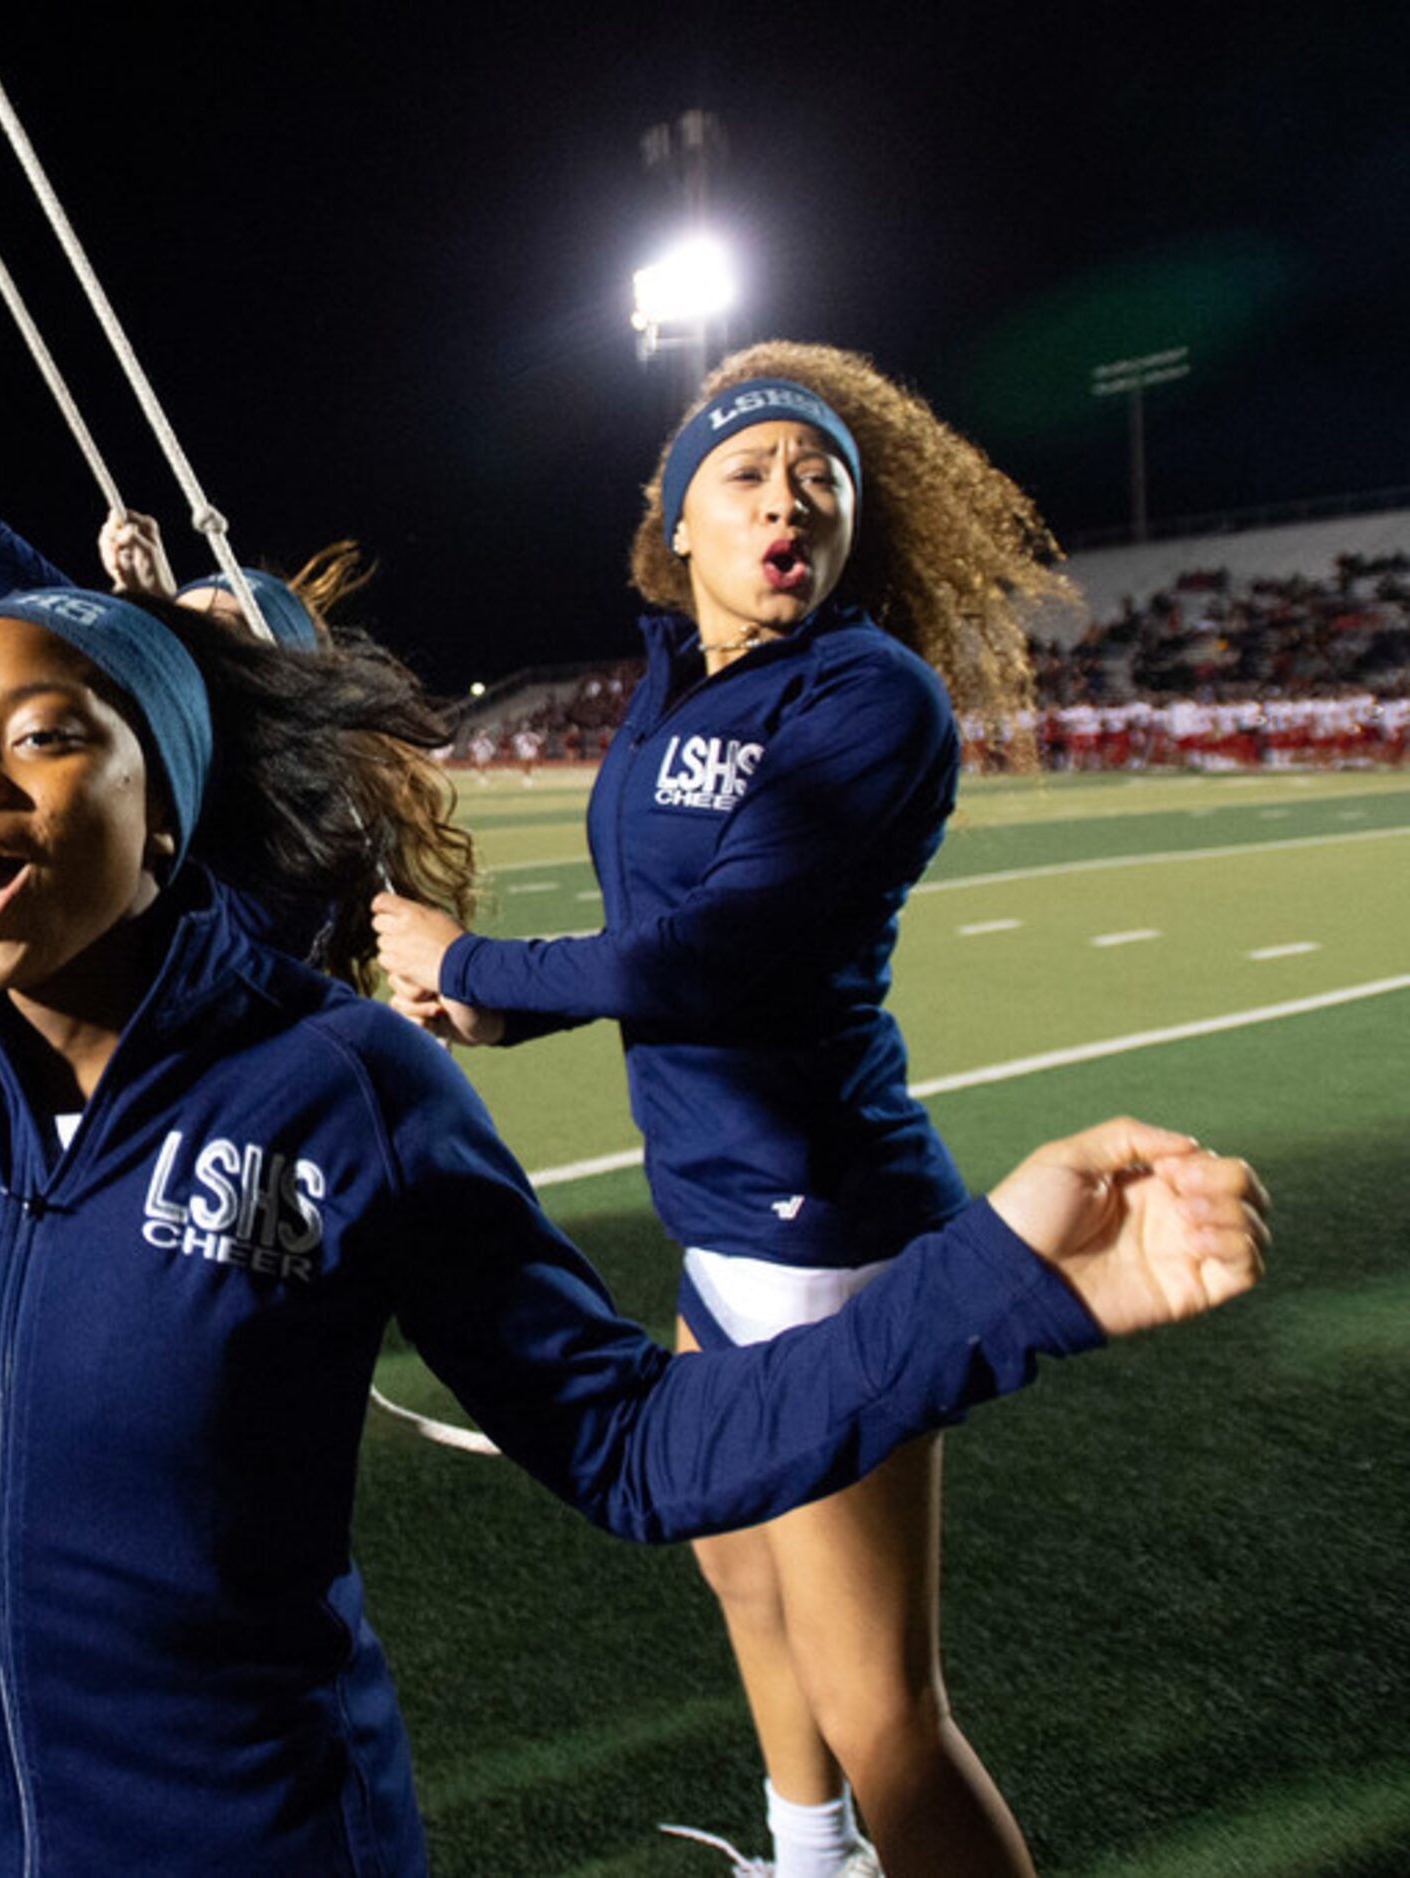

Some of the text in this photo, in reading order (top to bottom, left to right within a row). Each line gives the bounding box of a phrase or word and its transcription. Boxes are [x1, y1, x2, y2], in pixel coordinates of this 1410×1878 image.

[656, 735, 765, 797] LSHS
[654, 789, 739, 812] CHEE
[143, 1130, 326, 1254] LSHS
[141, 1219, 314, 1284] CHEER
